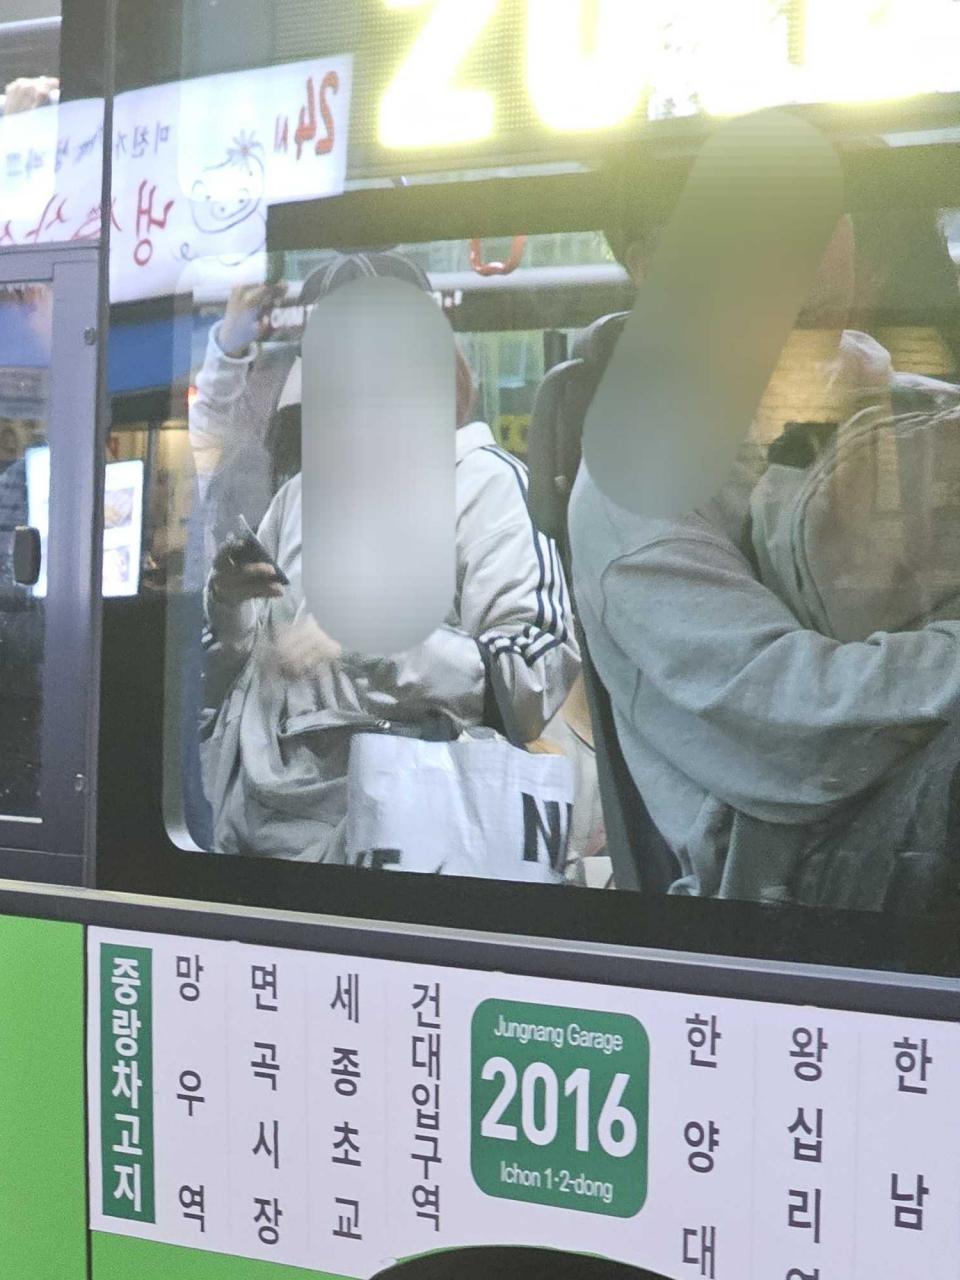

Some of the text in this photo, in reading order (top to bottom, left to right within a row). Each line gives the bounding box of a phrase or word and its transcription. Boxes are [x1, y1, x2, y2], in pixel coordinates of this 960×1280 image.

[110, 957, 144, 1213] 중랑차고지
[175, 953, 206, 1233] 망우역
[250, 963, 283, 1246] 면곡시장
[330, 972, 363, 1241] 세종초교
[411, 982, 442, 1232] 건대입구역
[480, 1056, 638, 1158] 2016
[494, 1014, 624, 1053] Jungnang Garage
[682, 1013, 722, 1280] 한양대
[499, 1160, 541, 1188] Ichon
